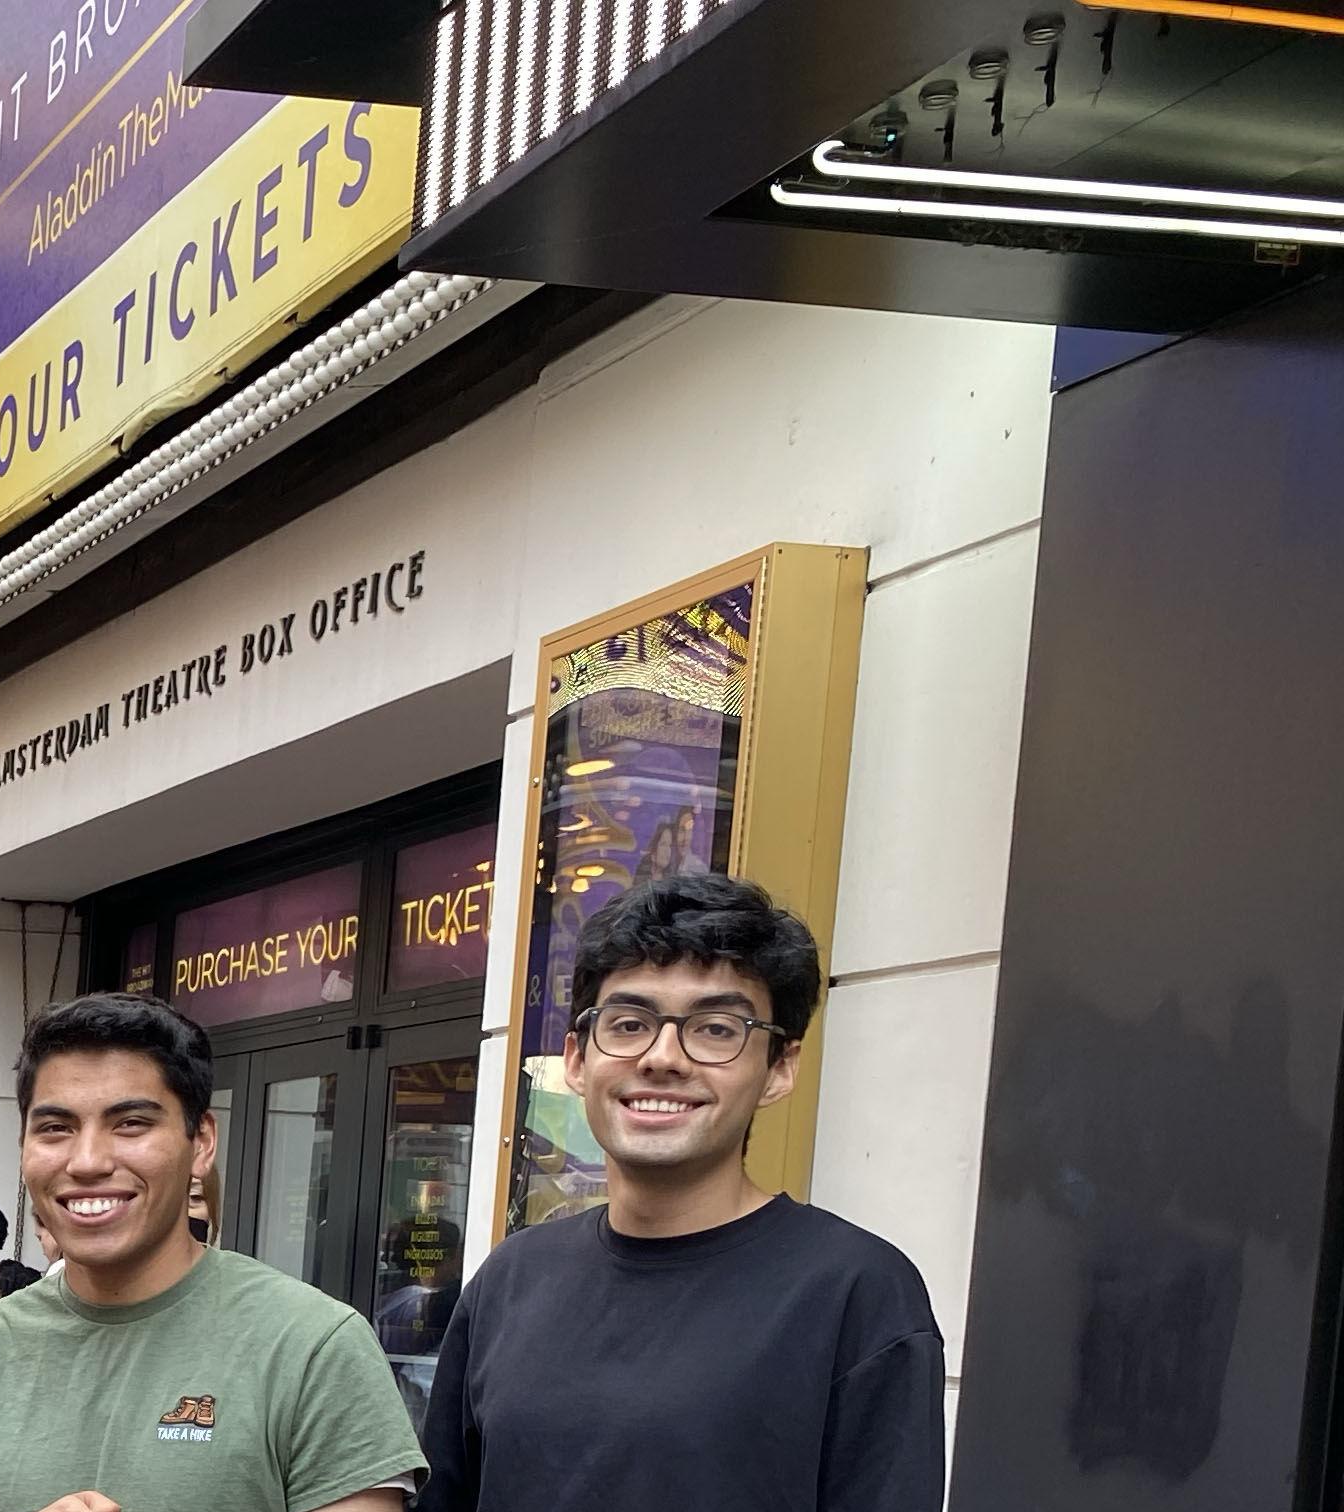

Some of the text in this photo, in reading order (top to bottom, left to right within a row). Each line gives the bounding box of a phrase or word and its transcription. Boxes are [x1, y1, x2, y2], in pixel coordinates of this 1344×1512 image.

[112, 101, 373, 388] TICKETS
[121, 645, 228, 729] THEATRE
[238, 613, 296, 673] BOX
[310, 550, 427, 642] OFFICE
[174, 932, 290, 997] PURCHASE
[295, 914, 360, 969] YOUR
[157, 1427, 213, 1442] TAKE A HIKE
